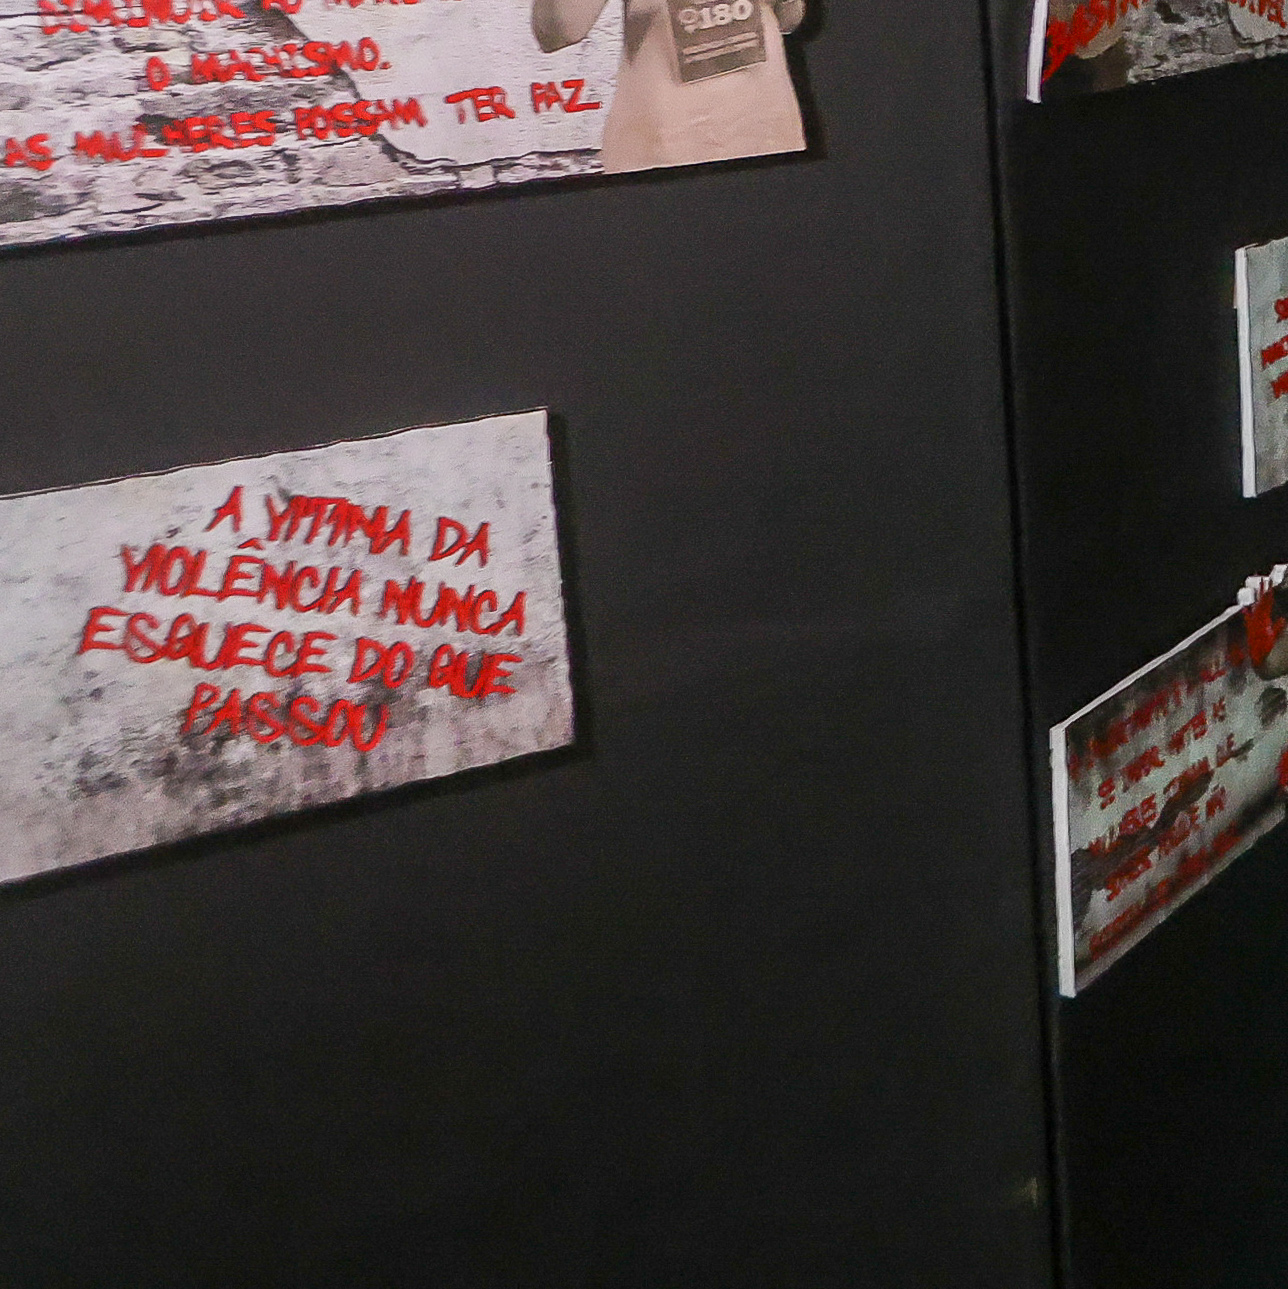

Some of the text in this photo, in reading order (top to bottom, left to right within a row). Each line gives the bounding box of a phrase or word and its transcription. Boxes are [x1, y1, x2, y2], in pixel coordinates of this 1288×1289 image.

[145, 56, 172, 92] O
[3, 133, 54, 171] AS
[73, 110, 277, 162] MULHERES
[295, 96, 428, 141] POSSAM
[445, 86, 516, 124] TER
[205, 485, 244, 532] A
[429, 516, 490, 567] DA
[120, 538, 527, 637] VIOLÊNCIA NUNCA
[78, 606, 523, 701] ESQUECE DO QUE
[180, 682, 390, 753] PASSOU
